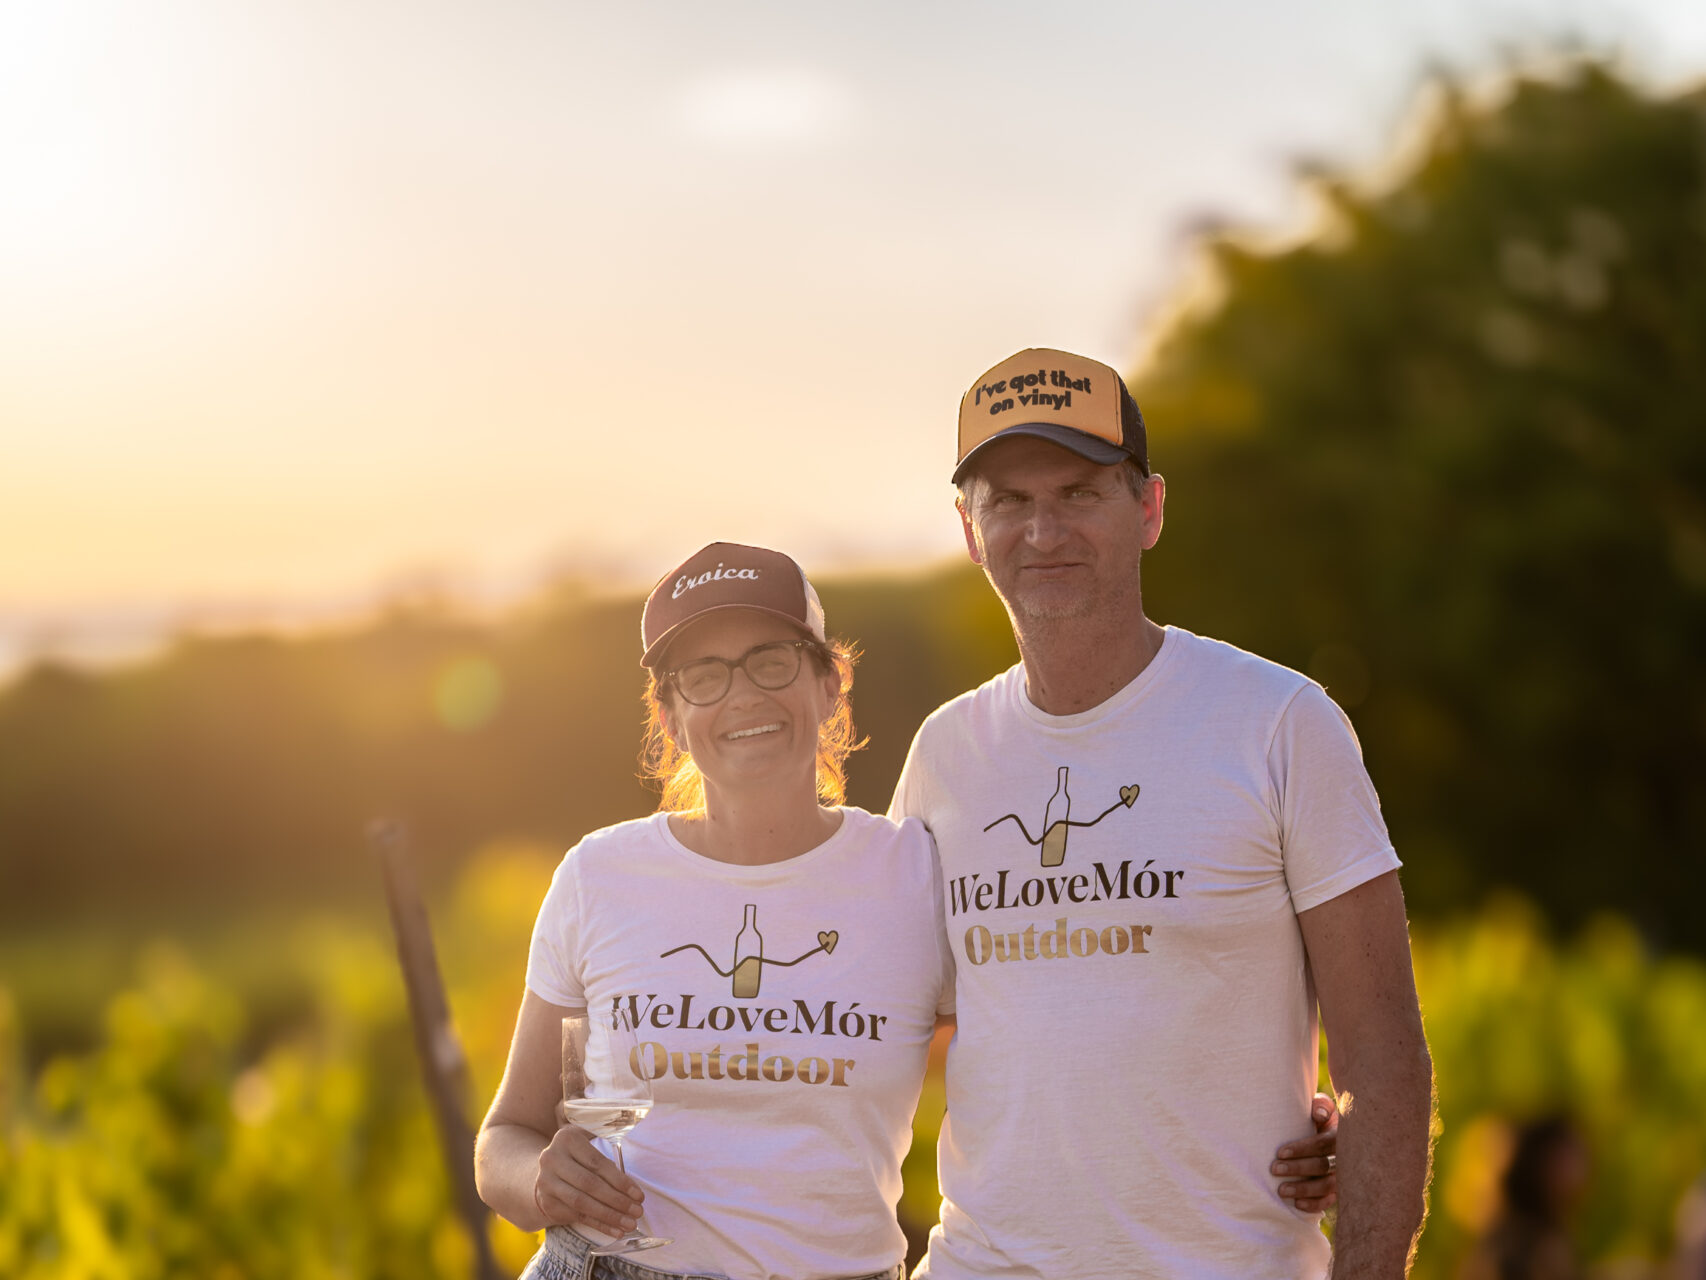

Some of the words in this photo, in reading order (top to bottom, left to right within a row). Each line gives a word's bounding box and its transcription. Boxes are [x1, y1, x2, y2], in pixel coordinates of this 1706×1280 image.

[976, 381, 1007, 406] I've
[1009, 370, 1047, 393] got
[1050, 370, 1091, 394] that
[990, 398, 1014, 415] on
[1018, 388, 1071, 410] vinyl
[671, 562, 759, 599] Eroica
[949, 859, 1185, 917] WeLoveMór
[964, 917, 1153, 966] Outdoor
[611, 994, 888, 1041] WeLoveMór
[628, 1041, 856, 1087] Outdoor
